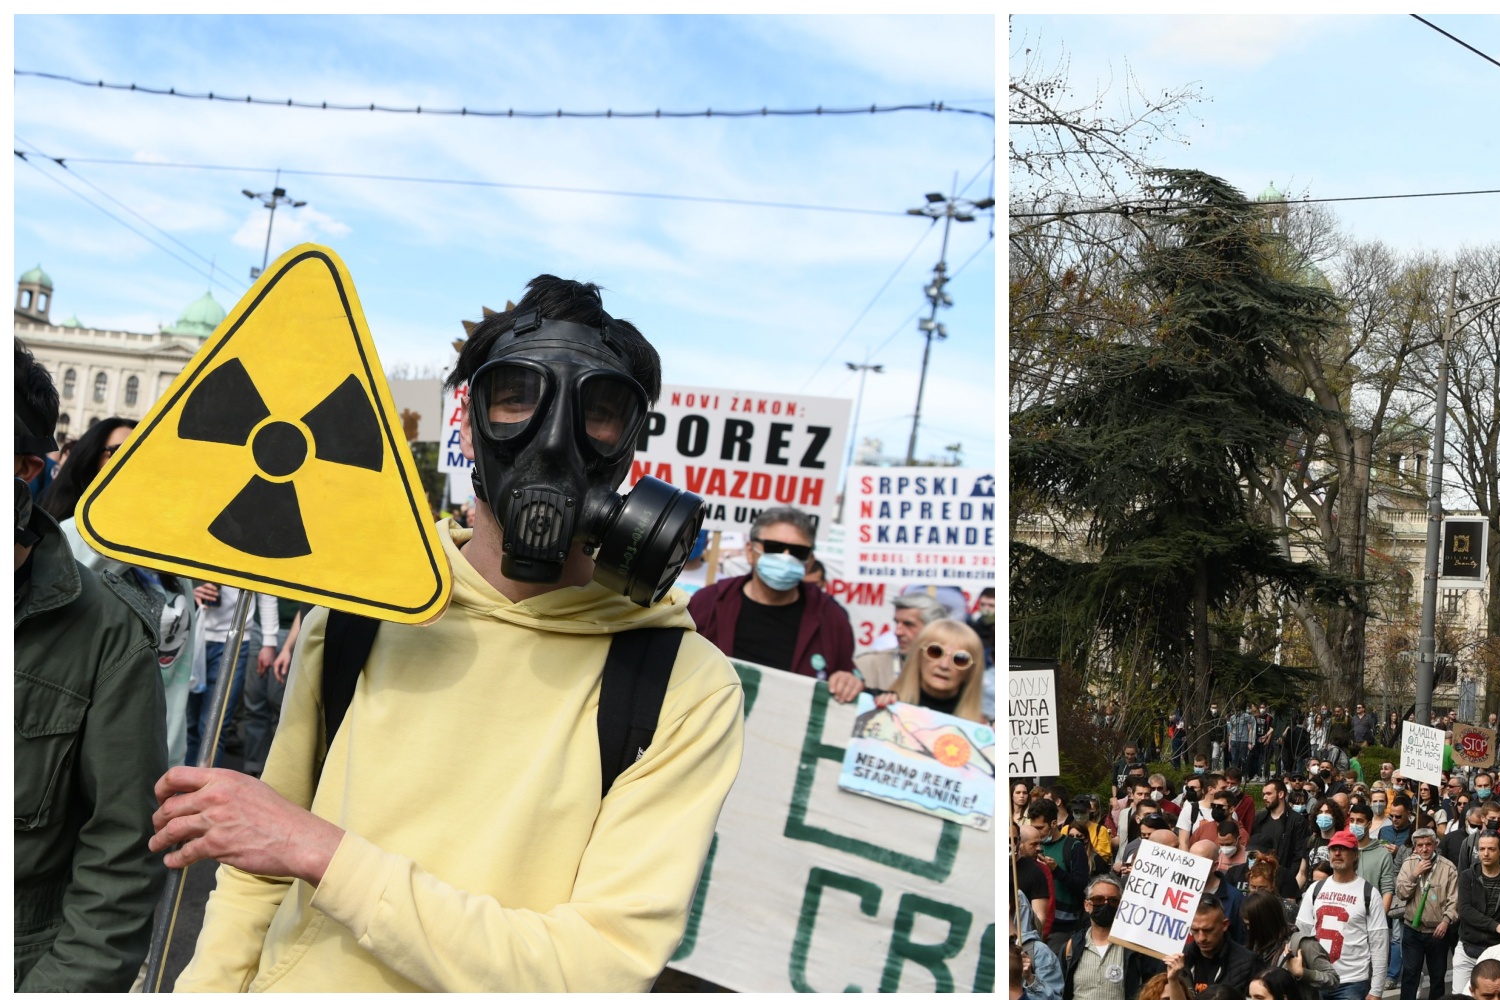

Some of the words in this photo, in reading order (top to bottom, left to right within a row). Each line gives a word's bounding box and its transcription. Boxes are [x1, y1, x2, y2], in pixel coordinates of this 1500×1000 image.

[670, 391, 721, 411] NOVI
[730, 396, 806, 418] ZAKON:
[637, 410, 833, 470] POREZ
[685, 465, 826, 507] VAZDUH
[861, 475, 958, 496] SRPSKI
[860, 500, 995, 521] NAPREDN
[1463, 737, 1488, 753] STOP
[853, 766, 899, 788] STARE
[901, 779, 978, 810] PLANINE!
[855, 752, 918, 779] NEDAMO
[921, 769, 962, 793] REKE
[1125, 875, 1159, 899] RECI
[1161, 886, 1195, 914] NE
[1115, 899, 1148, 926] RIO
[1147, 909, 1190, 942] TINTU
[1315, 904, 1350, 965] 6
